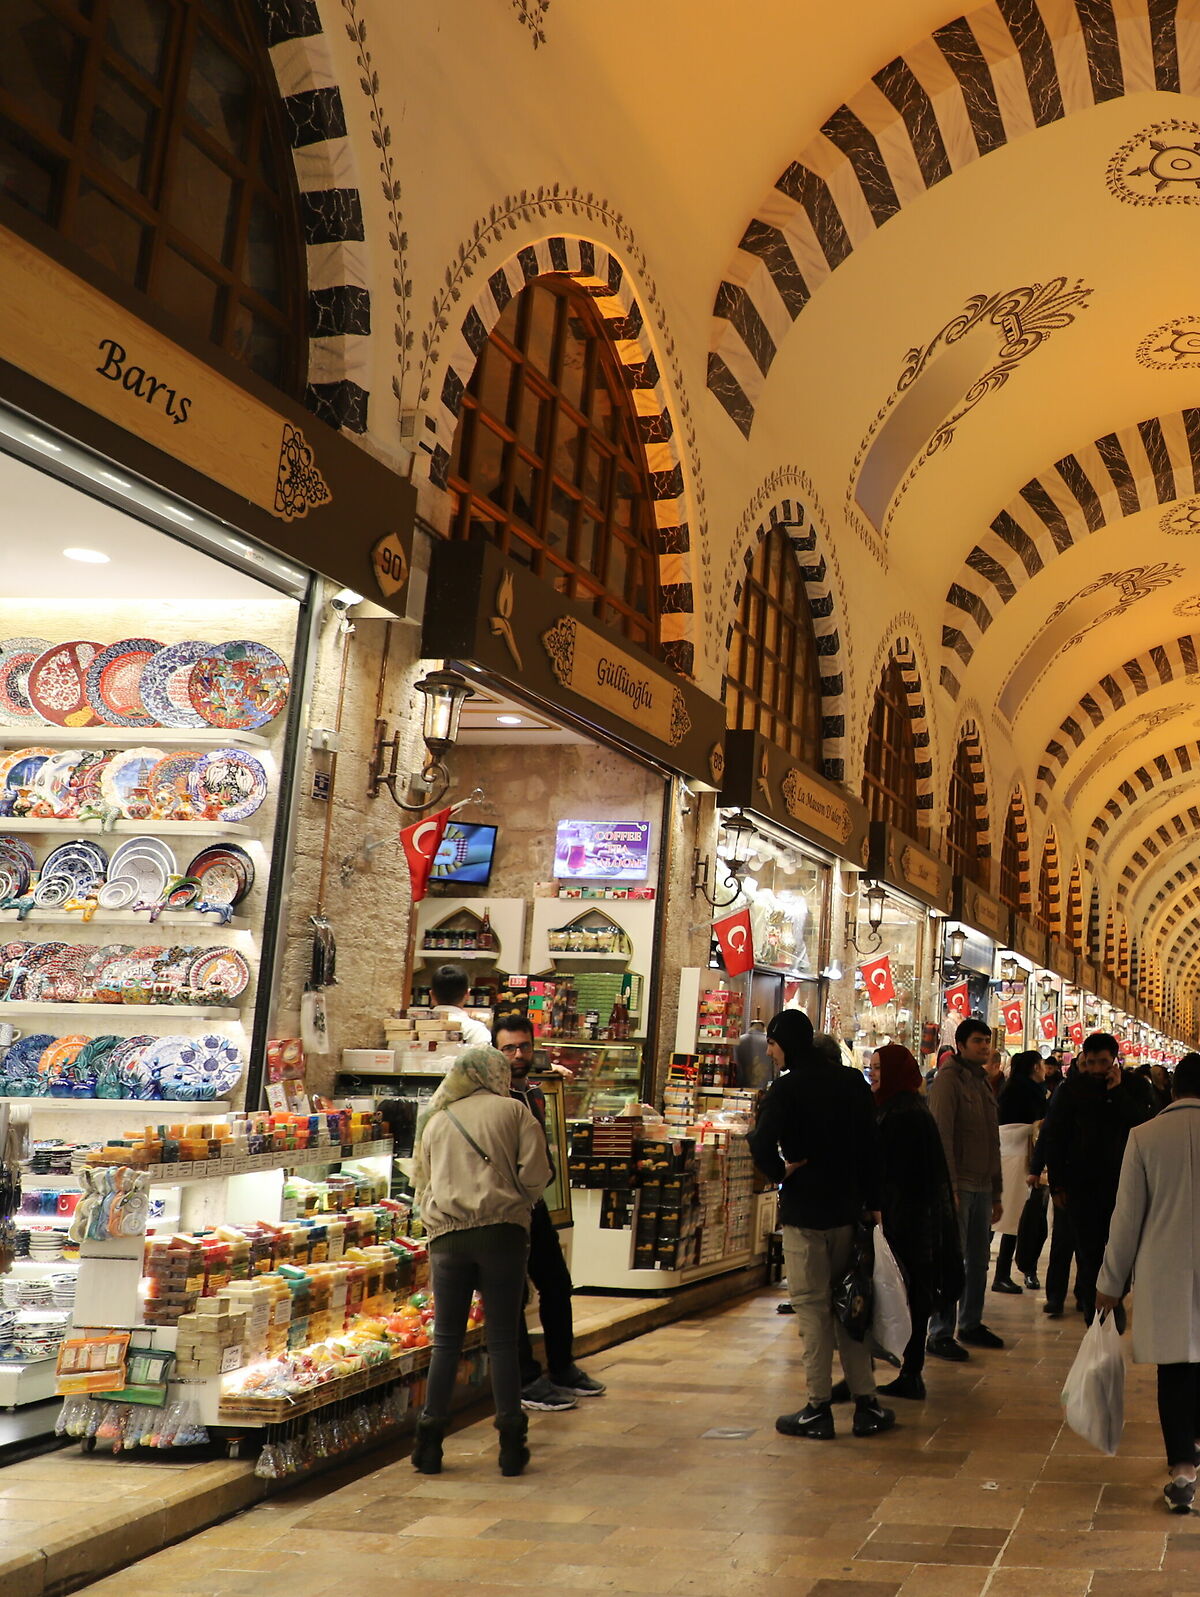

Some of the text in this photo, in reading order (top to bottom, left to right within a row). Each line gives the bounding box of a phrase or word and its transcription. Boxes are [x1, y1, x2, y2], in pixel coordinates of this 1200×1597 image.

[95, 339, 192, 425] Barış
[381, 547, 402, 582] 90
[597, 657, 653, 710] Güllüoğlu
[713, 751, 723, 772] 88
[594, 831, 642, 842] COFFEE
